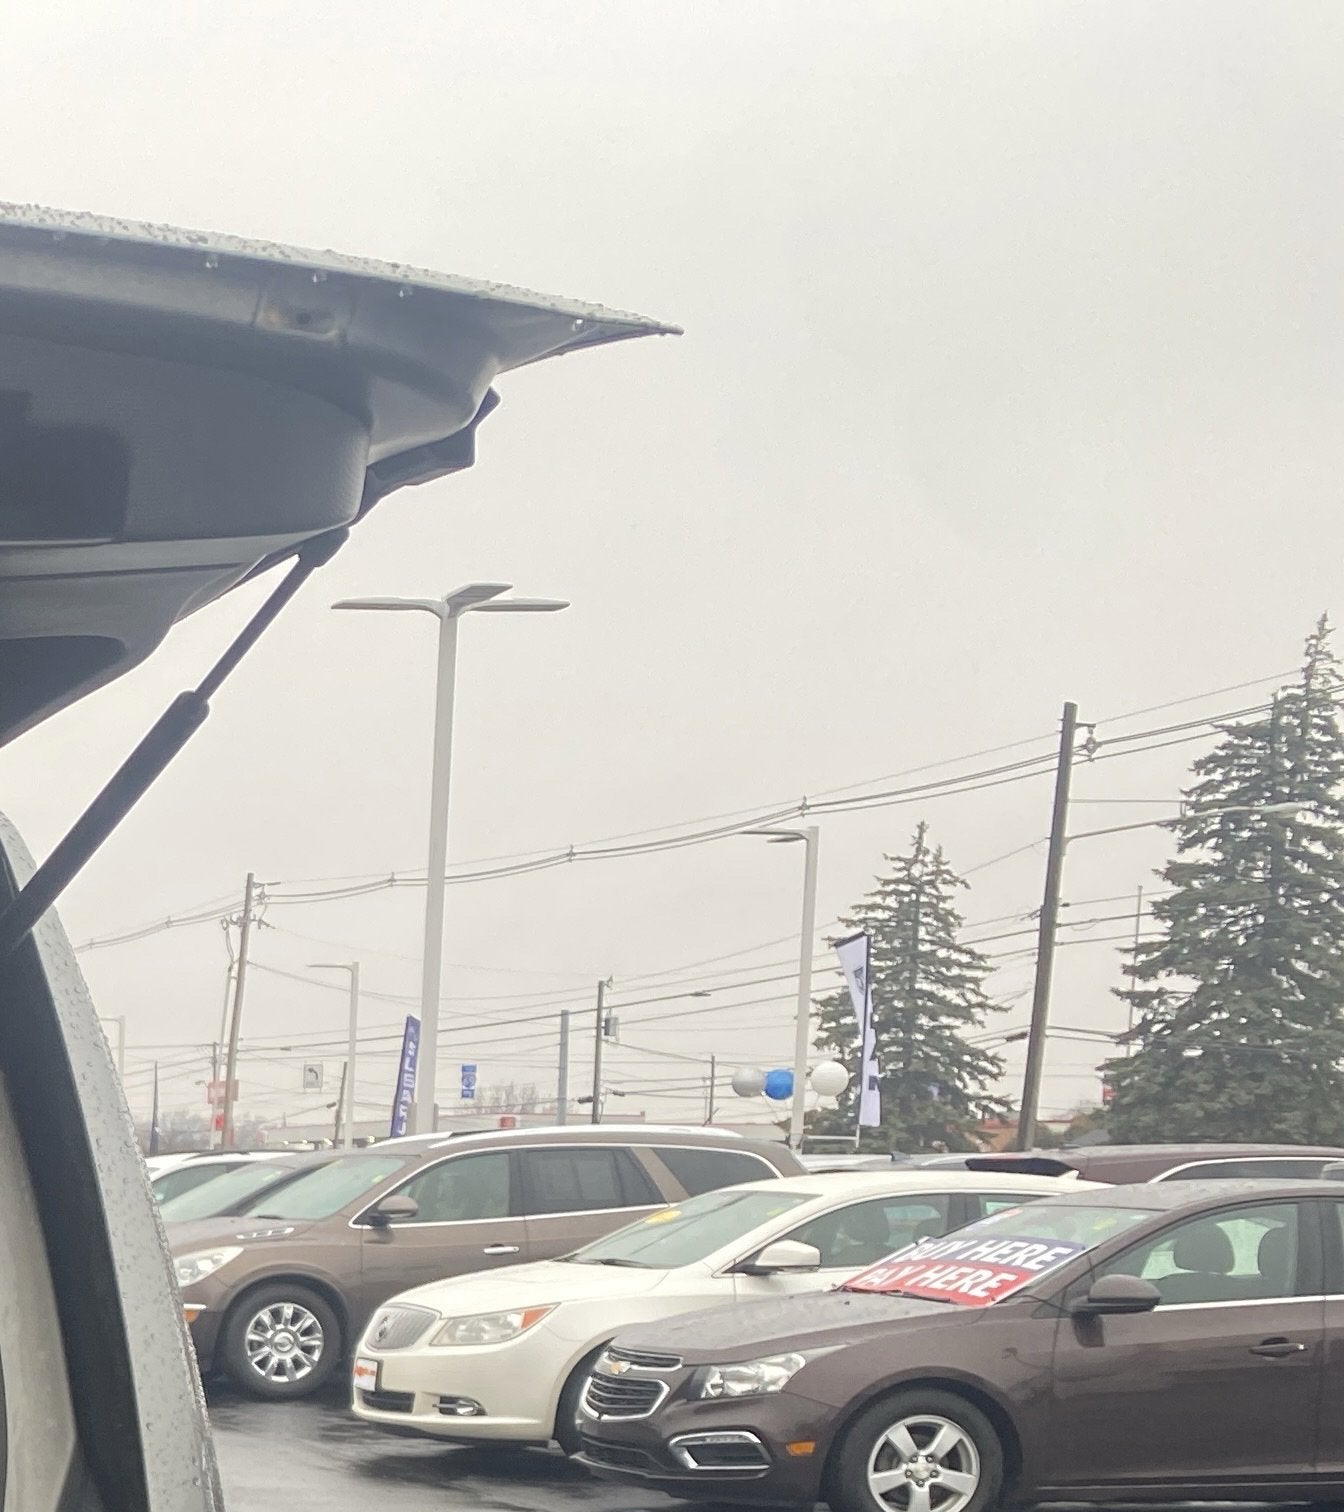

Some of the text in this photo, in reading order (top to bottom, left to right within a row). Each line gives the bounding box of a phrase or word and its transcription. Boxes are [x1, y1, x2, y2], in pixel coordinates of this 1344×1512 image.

[891, 1240, 1073, 1270] BUY HERE
[853, 1265, 1018, 1297] PAY HERE
